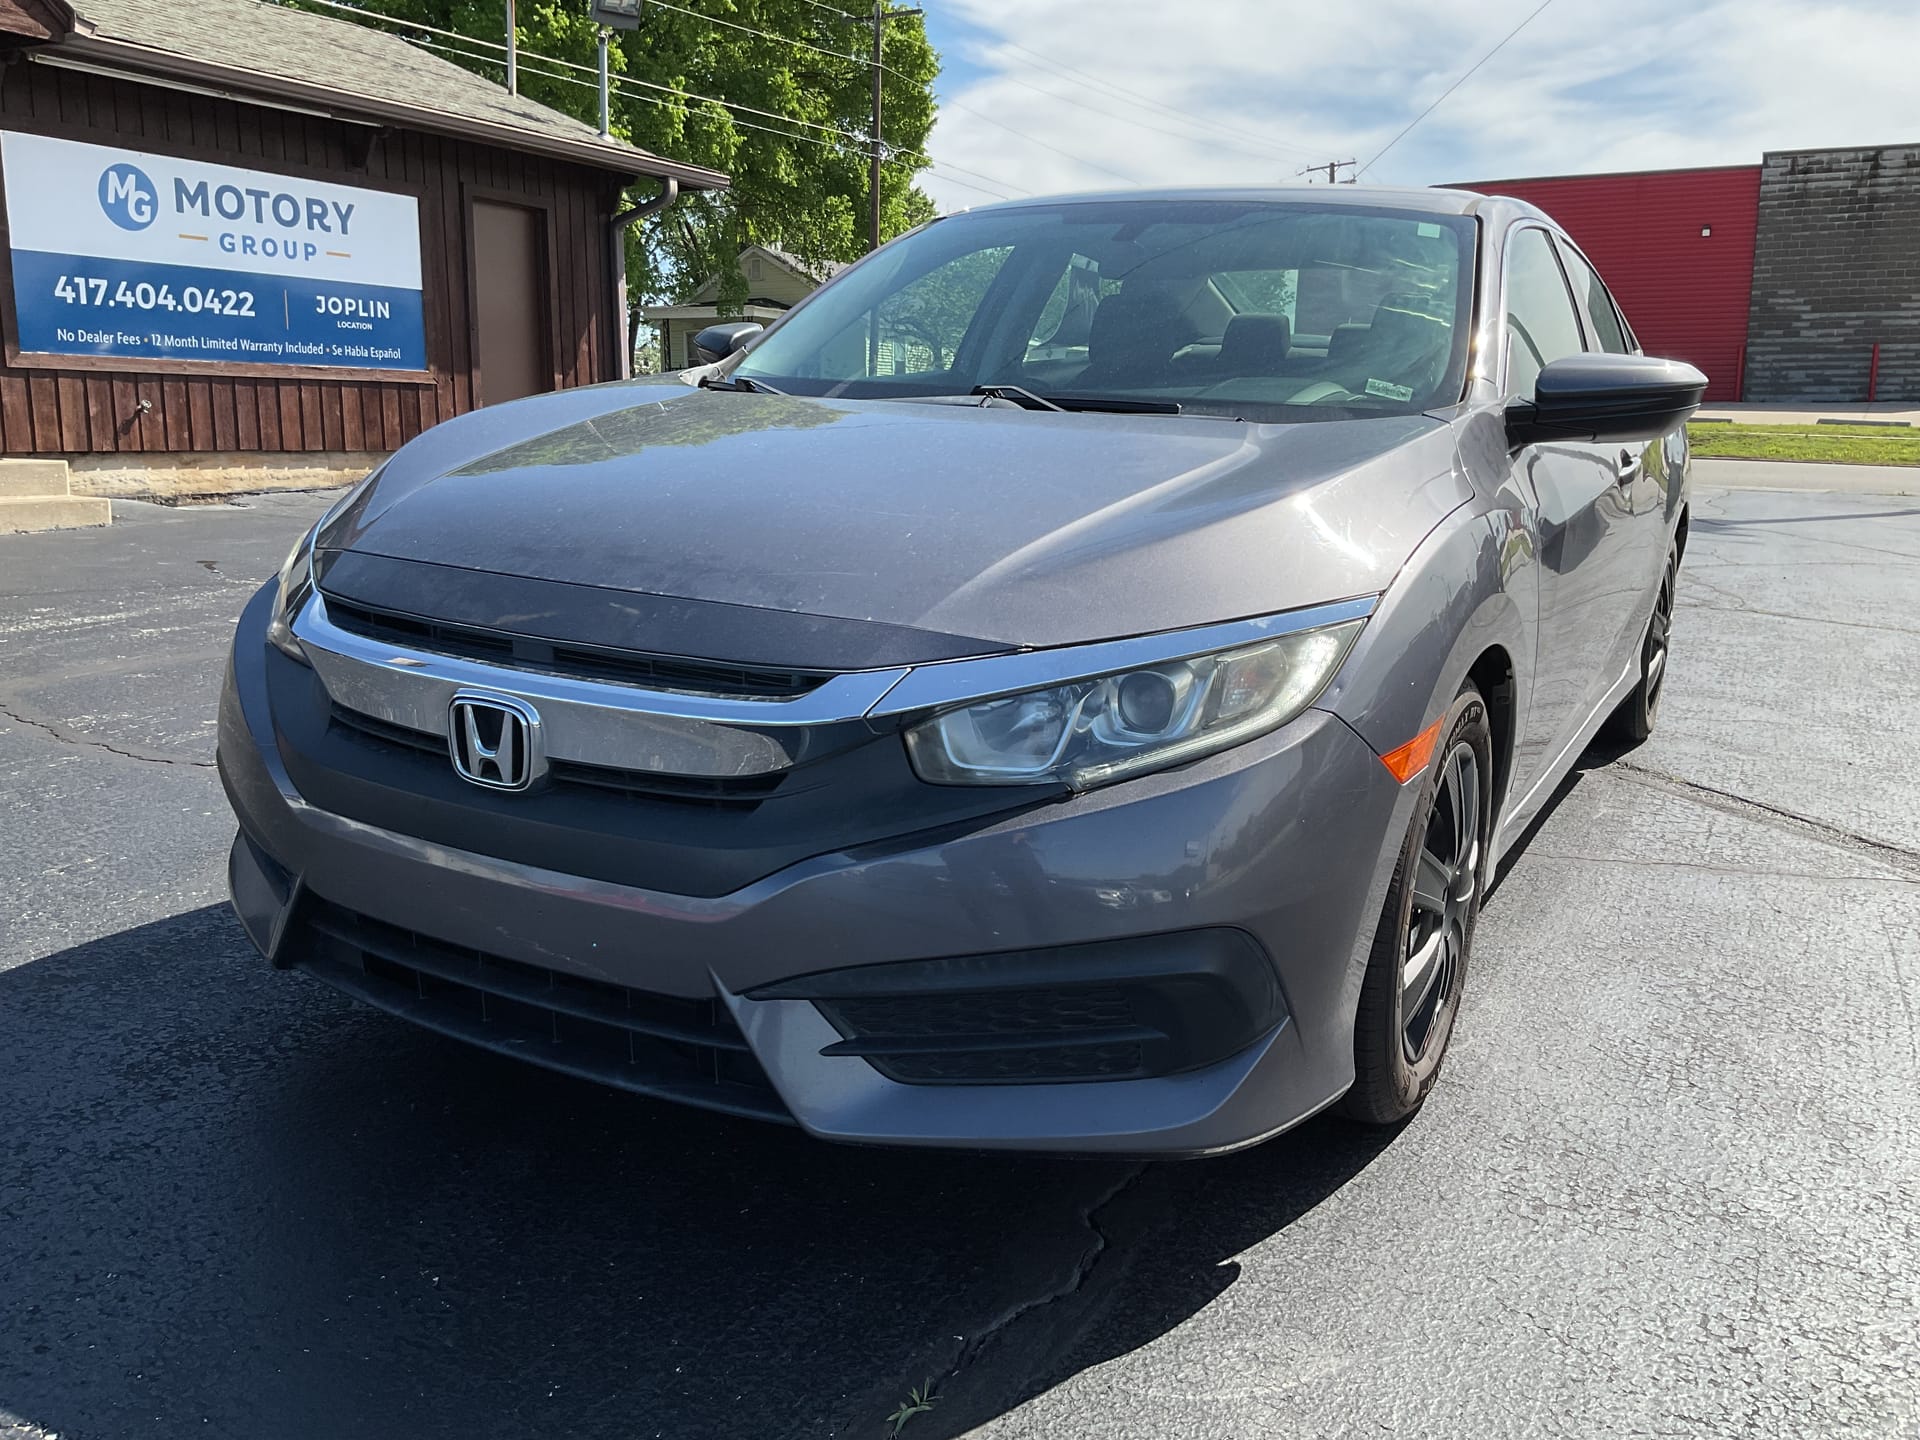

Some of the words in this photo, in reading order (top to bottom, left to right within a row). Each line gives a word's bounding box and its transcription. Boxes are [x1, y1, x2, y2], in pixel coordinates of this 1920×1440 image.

[174, 177, 355, 236] MOTORY
[219, 232, 317, 261] GROUP
[54, 275, 256, 317] 417.404.0422
[315, 295, 390, 319] JOPLIN
[337, 320, 373, 330] LOCATION
[57, 328, 75, 342] No
[78, 329, 114, 344] Dealer
[117, 332, 141, 345] Fees
[151, 333, 162, 346] 12
[164, 334, 199, 348] Month
[201, 337, 238, 350] Limited
[240, 339, 283, 355] Warranty
[285, 341, 324, 355] Included
[332, 344, 343, 355] Se
[345, 345, 369, 358] Habla
[370, 348, 401, 360] Español
